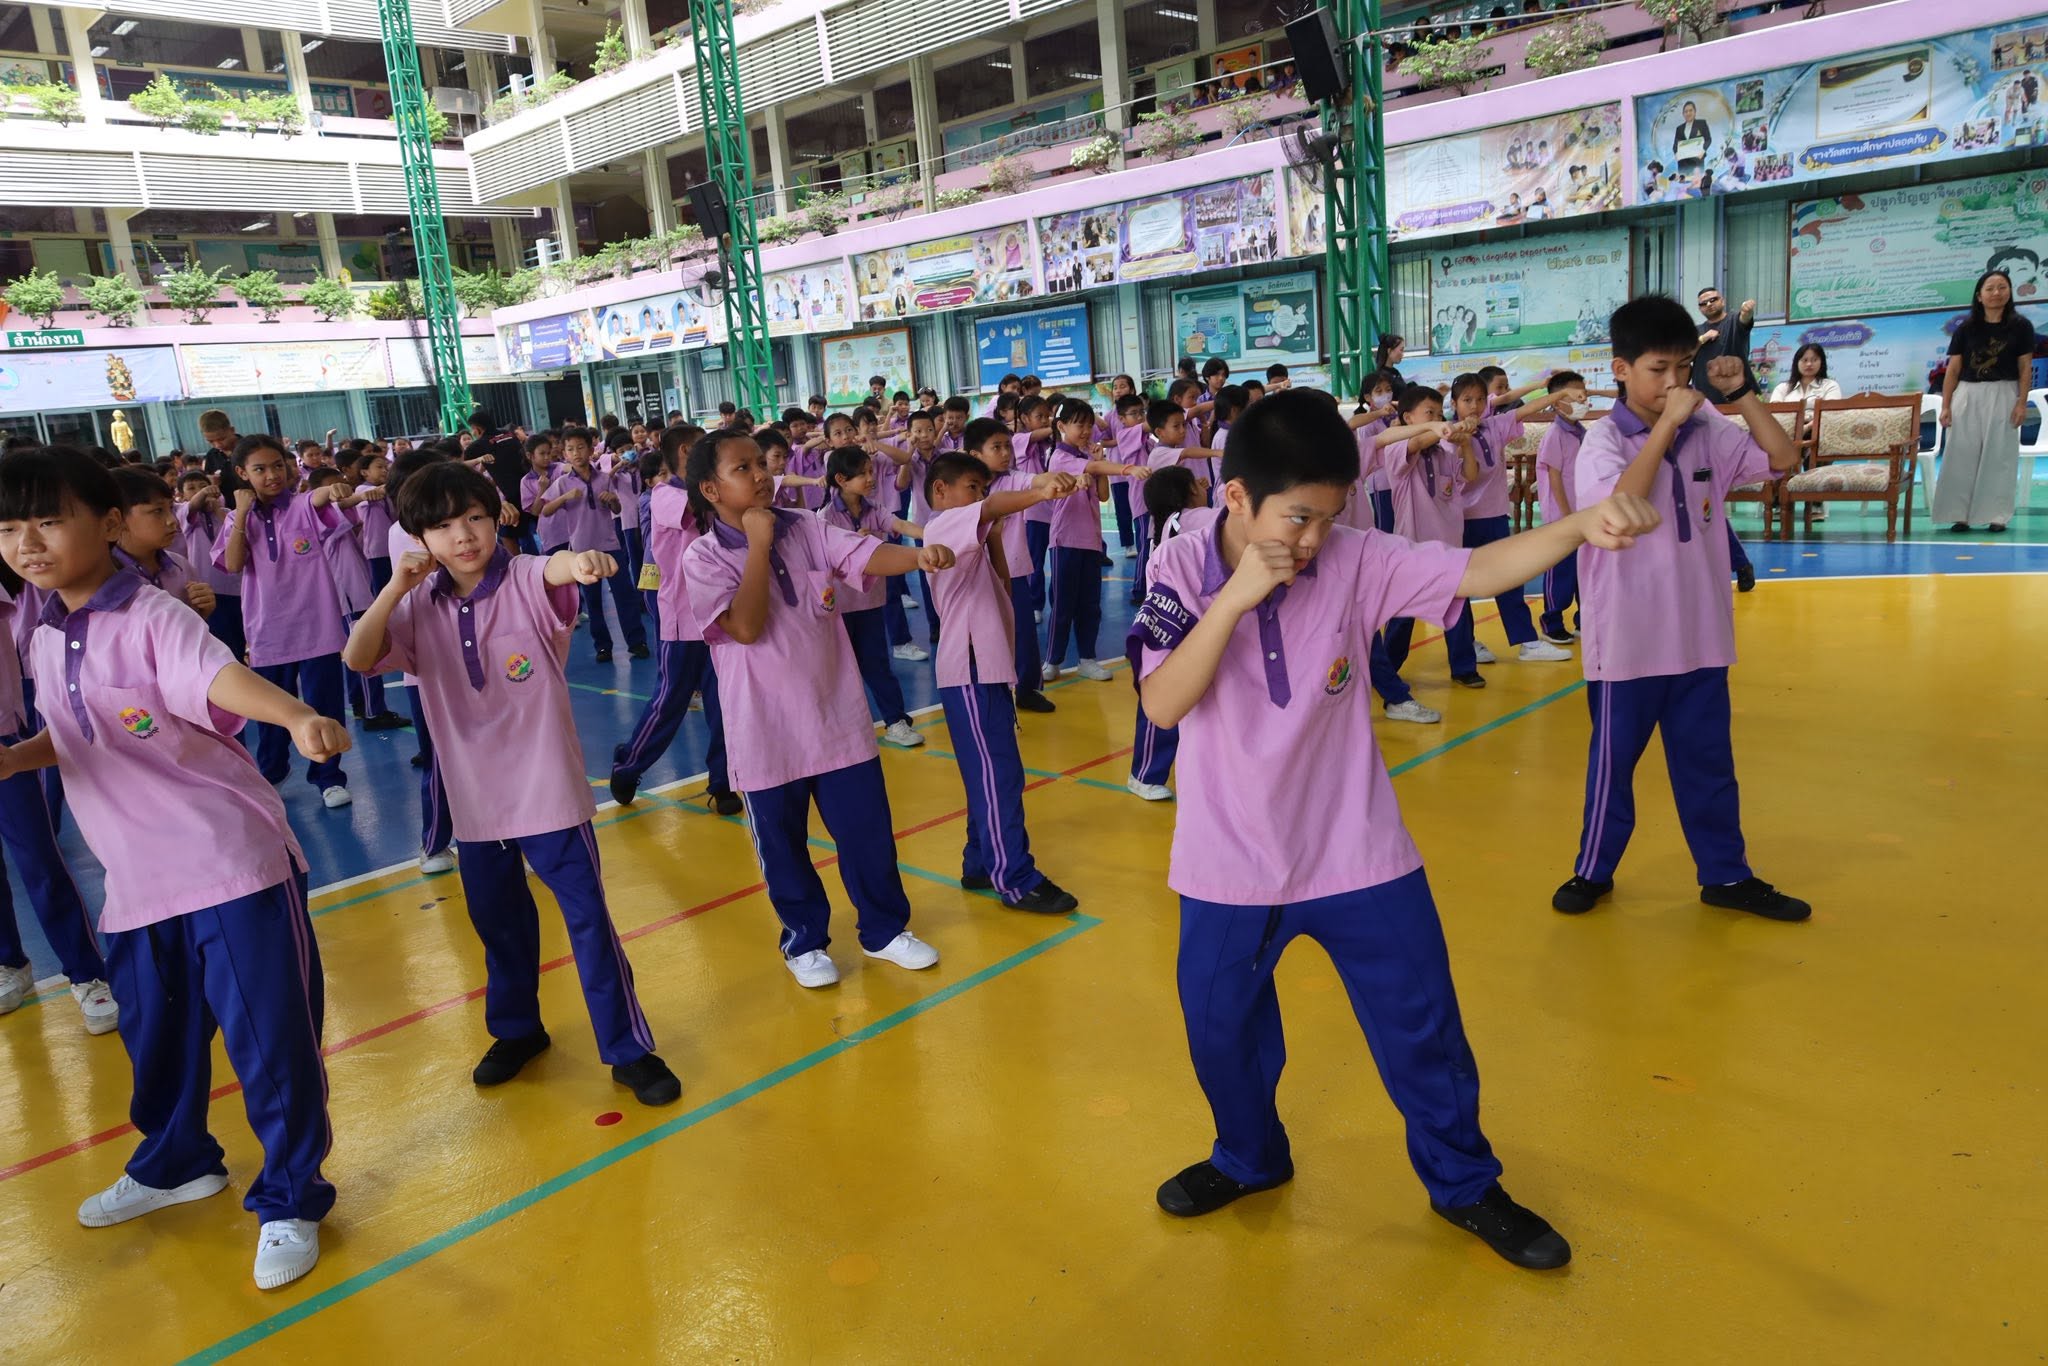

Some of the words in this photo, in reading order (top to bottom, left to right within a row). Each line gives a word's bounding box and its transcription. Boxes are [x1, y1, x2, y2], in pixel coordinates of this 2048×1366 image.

[1812, 133, 1928, 160] รางวัลสถานศึกษาปลอดภัย
[1454, 255, 1480, 265] Foreign
[1482, 250, 1517, 263] Language
[1520, 244, 1568, 258] Department
[1546, 255, 1582, 270] What
[13, 331, 79, 346] สำนักงาน
